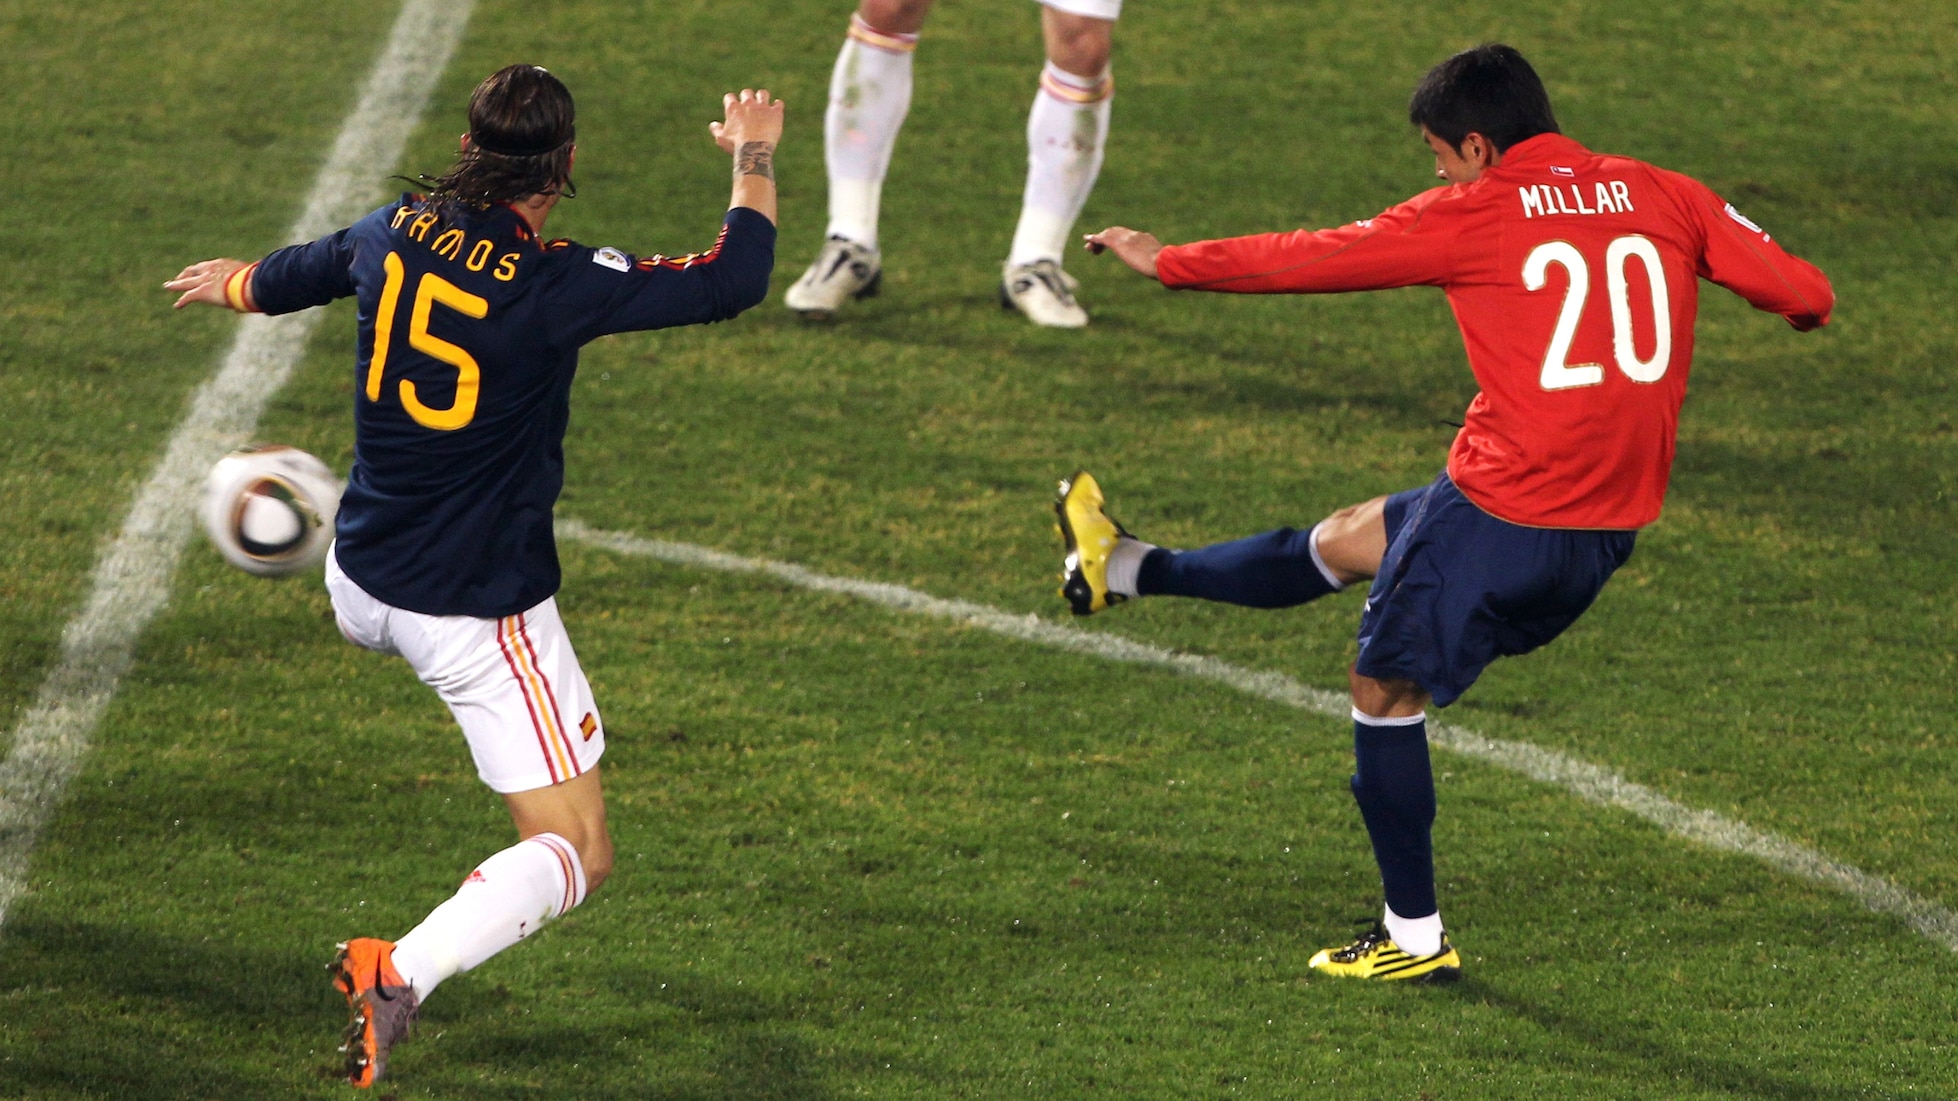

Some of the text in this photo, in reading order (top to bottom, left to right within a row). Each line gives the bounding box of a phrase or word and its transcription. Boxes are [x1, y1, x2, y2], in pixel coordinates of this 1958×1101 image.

[1519, 180, 1634, 218] MILLAR
[365, 251, 489, 431] 15
[1521, 233, 1672, 391] 20
